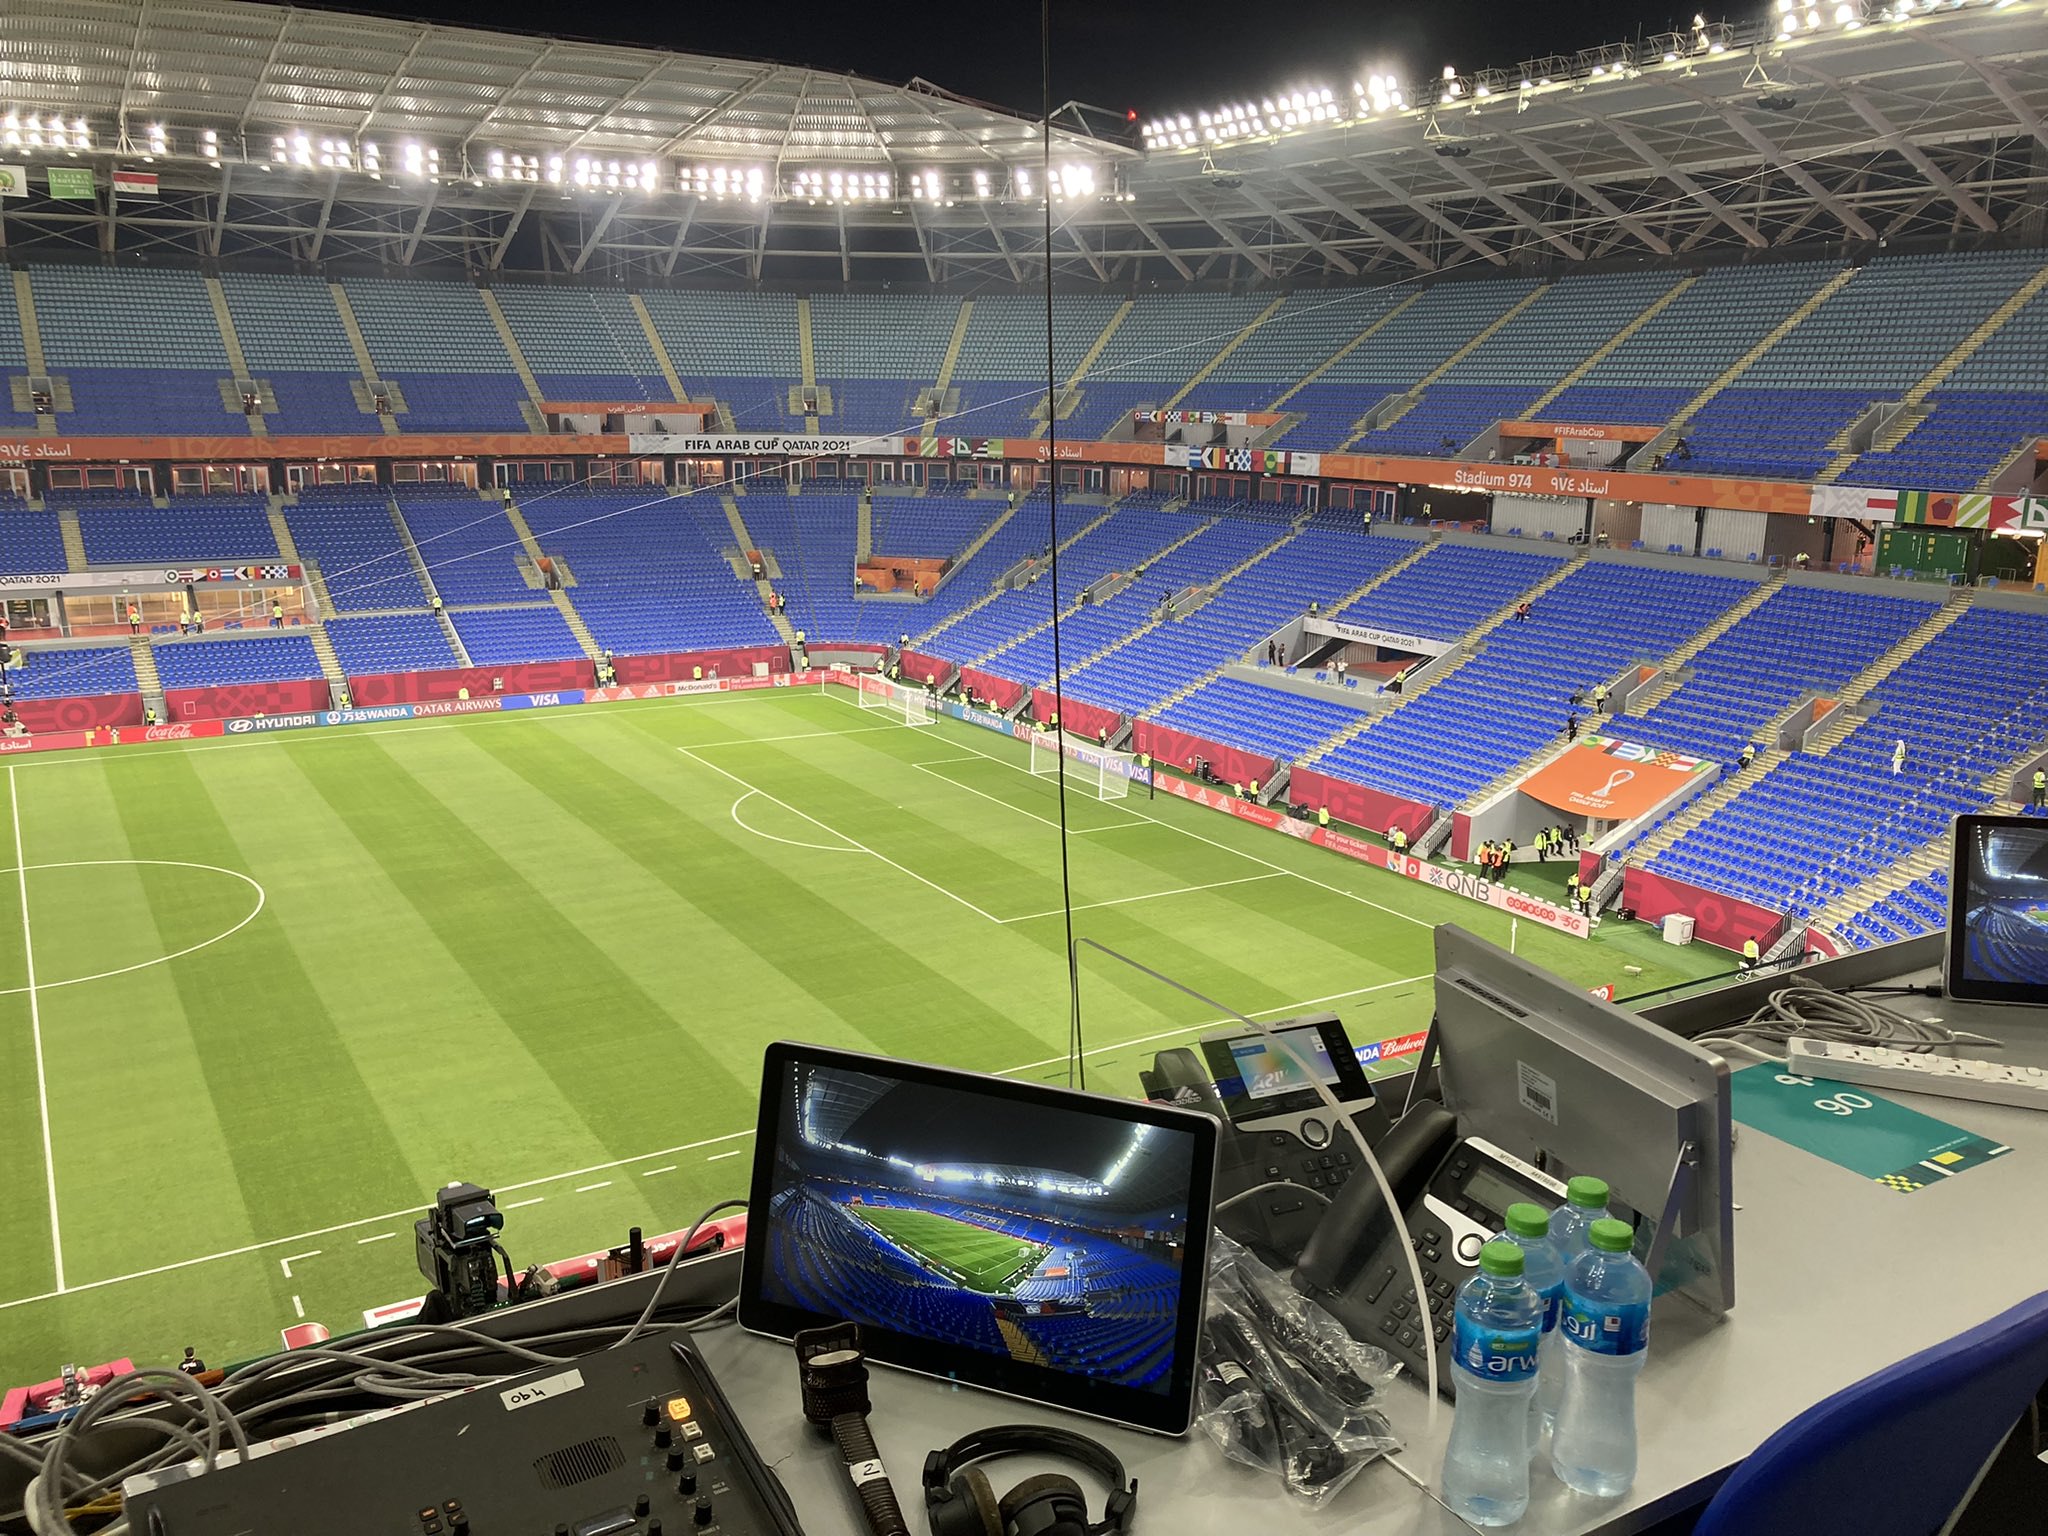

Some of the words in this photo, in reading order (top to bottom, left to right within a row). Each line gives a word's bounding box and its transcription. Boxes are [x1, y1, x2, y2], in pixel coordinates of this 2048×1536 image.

[1554, 426, 1605, 438] #FIFArabCup
[35, 443, 71, 456] استاد
[684, 440, 711, 450] FIFA
[715, 440, 750, 450] ARAB
[754, 440, 778, 450] CUP
[782, 440, 820, 452] QATAR
[822, 440, 850, 451] 2021
[1060, 445, 1082, 458] استاد
[1454, 470, 1505, 487] Stadium
[1508, 473, 1532, 489] 974
[1577, 478, 1609, 495] استاد
[0, 576, 33, 586] QATAR
[35, 575, 61, 584] 2021
[1337, 626, 1350, 635] FIFA
[1351, 629, 1368, 639] ARAB
[1368, 632, 1380, 641] CUP
[1381, 634, 1400, 644] QATAR
[1400, 638, 1415, 647] 2021
[677, 682, 718, 692] McDonald's
[412, 701, 451, 716] QATAR
[454, 698, 502, 712] AIRWAYS
[528, 693, 560, 707] VISA
[256, 715, 315, 730] HYUNDAI
[366, 708, 408, 721] WANDA
[145, 723, 193, 741] Coca-Cola
[1104, 757, 1124, 774] VISA
[1129, 765, 1149, 783] VISA
[1238, 804, 1273, 823] Budweiser
[1446, 872, 1489, 903] QNB
[1506, 896, 1556, 922] ooredoo
[1562, 915, 1581, 931] 5G
[1355, 1046, 1379, 1062] NDA
[1814, 1093, 1873, 1116] 90
[1487, 1355, 1536, 1373] arw
[863, 1462, 881, 1476] 2
